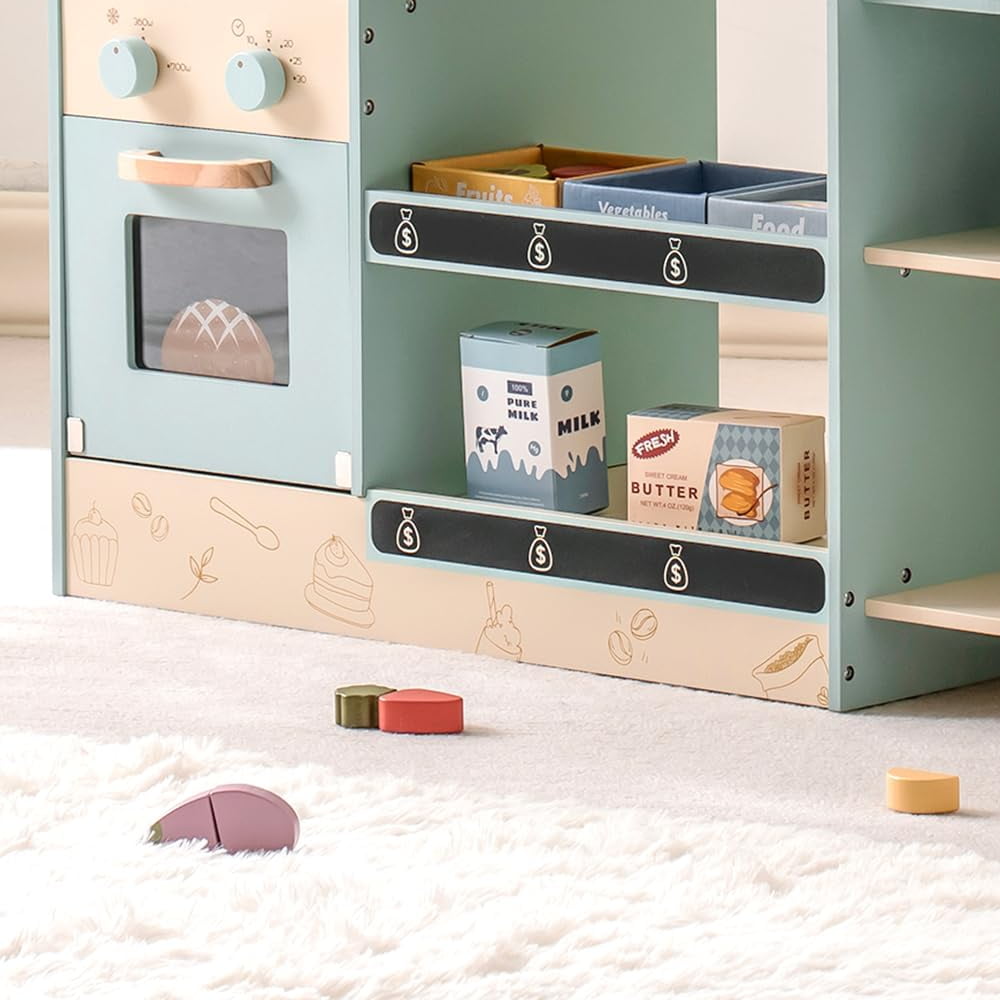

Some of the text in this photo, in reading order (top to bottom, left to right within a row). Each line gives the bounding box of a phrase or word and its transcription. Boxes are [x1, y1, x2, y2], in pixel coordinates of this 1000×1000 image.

[246, 35, 255, 45] 10
[283, 39, 294, 48] 20
[293, 56, 303, 65] 25
[296, 74, 307, 84] 30
[507, 397, 537, 409] PURE
[508, 409, 539, 421] MILK
[558, 410, 601, 436] MILK
[635, 430, 675, 456] FRESH
[631, 482, 698, 499] BUTTER
